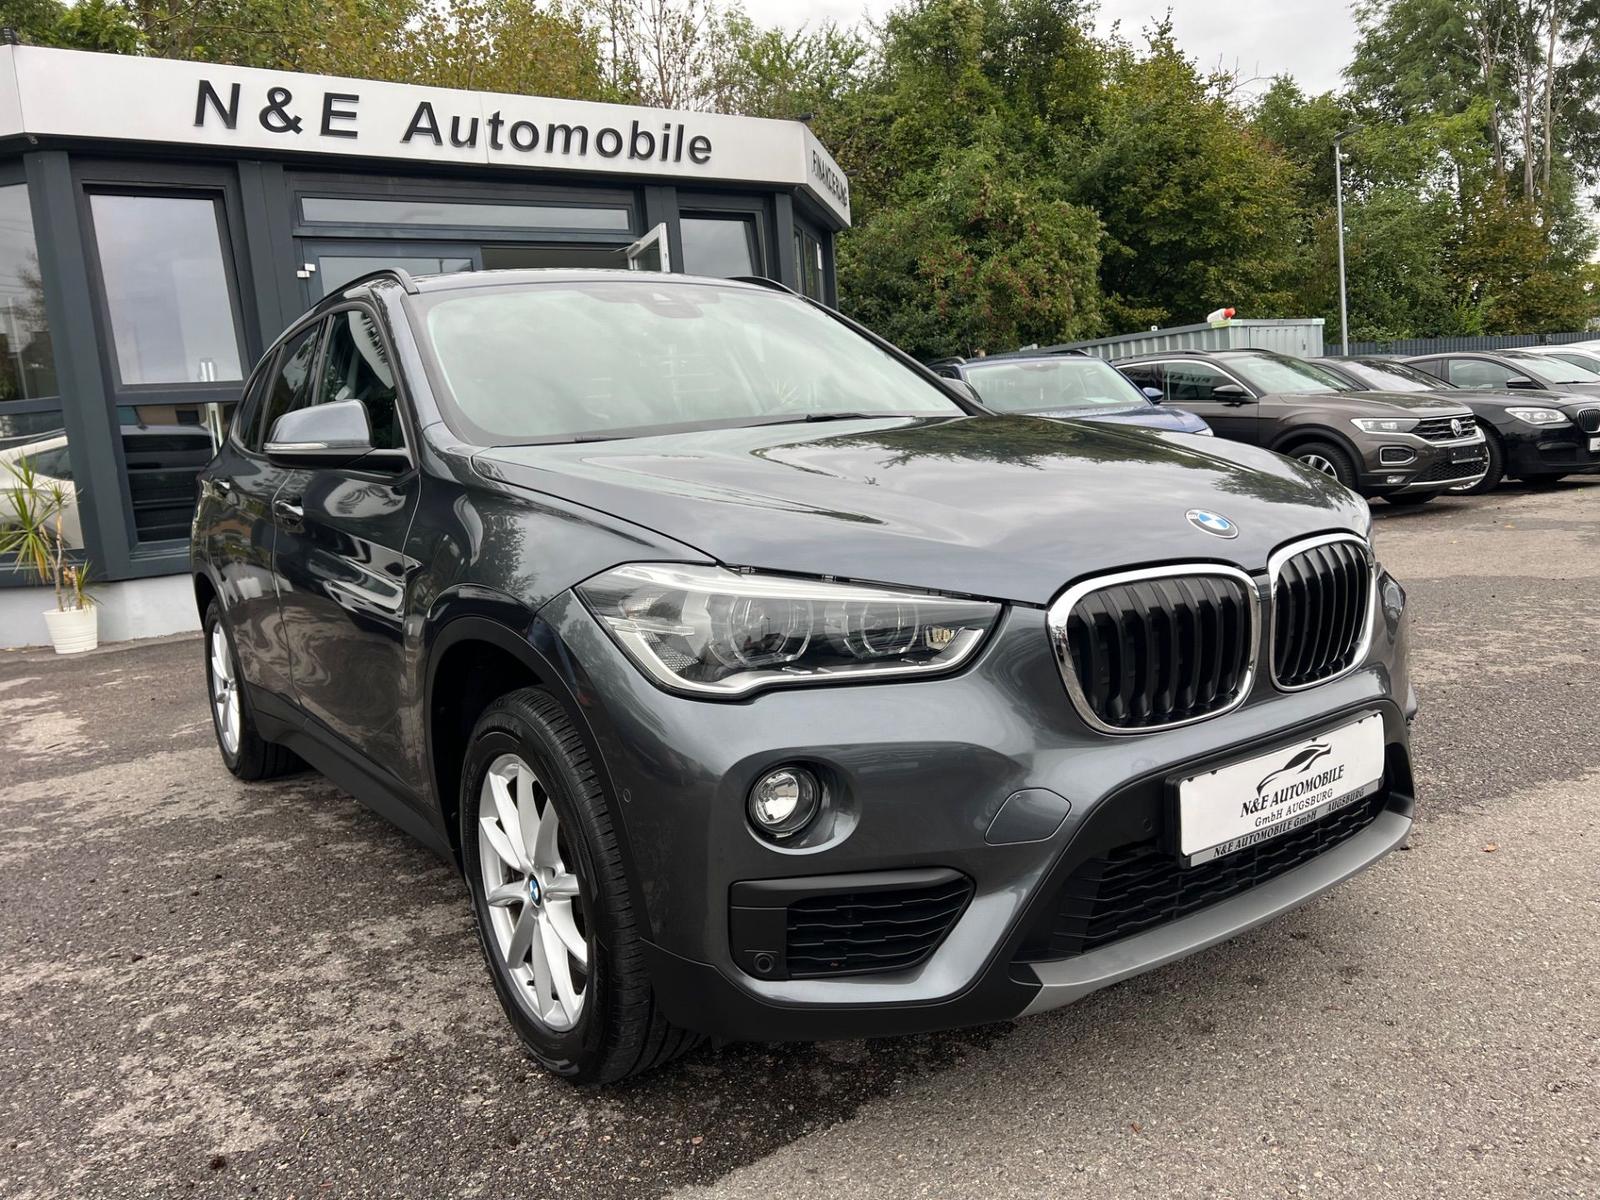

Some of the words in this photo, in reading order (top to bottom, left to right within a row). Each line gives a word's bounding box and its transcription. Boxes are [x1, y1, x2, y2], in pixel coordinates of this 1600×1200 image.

[400, 101, 713, 164] Automobile
[1240, 794, 1269, 818] N&E
[1269, 764, 1345, 808] AUTOMOBILE
[1255, 808, 1284, 828] GmbH
[1286, 788, 1333, 816] AUGSBURG
[1213, 842, 1234, 858] N&E
[1235, 821, 1292, 850] AUTOMOBILE
[1293, 810, 1318, 828] GmbH
[1327, 788, 1365, 812] AUGSBURG
